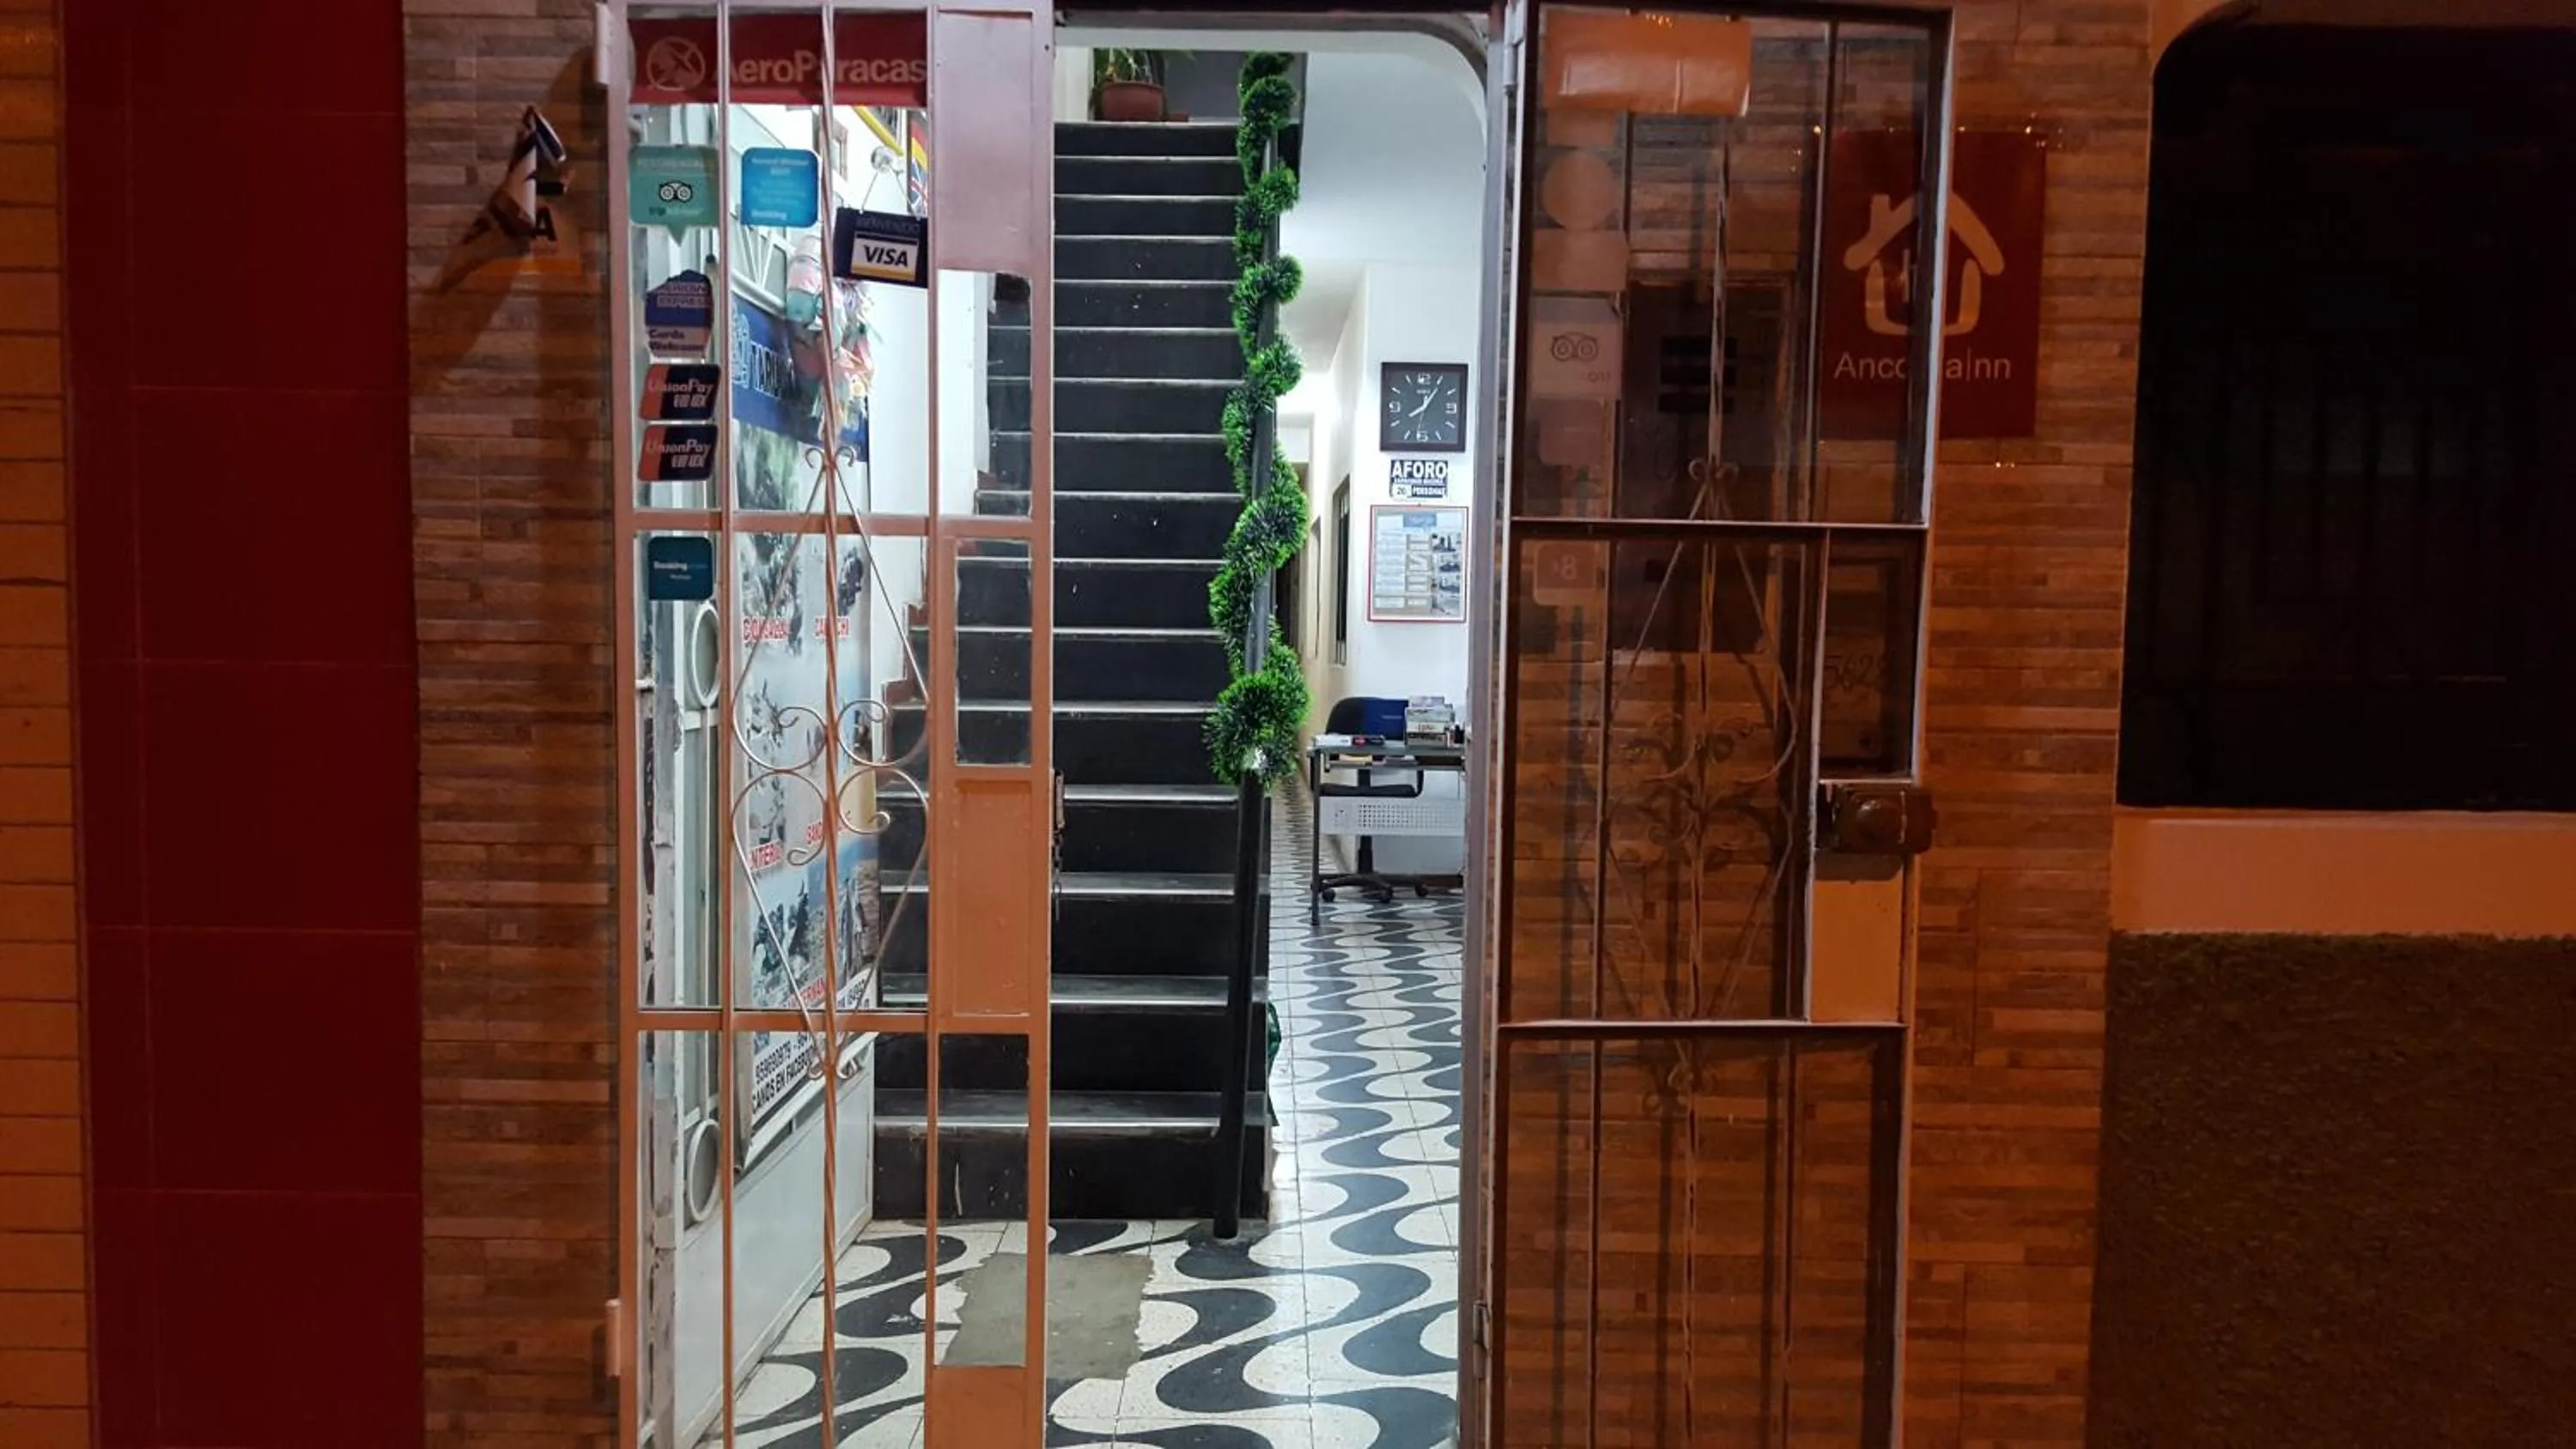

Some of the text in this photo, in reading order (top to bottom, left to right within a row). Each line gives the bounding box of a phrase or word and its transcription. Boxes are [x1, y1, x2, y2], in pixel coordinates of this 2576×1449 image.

[714, 50, 928, 84] eroPracas
[864, 246, 908, 267] VISA
[647, 379, 714, 395] UnionPay
[646, 439, 712, 455] UnionPay
[1393, 461, 1448, 478] AFORO
